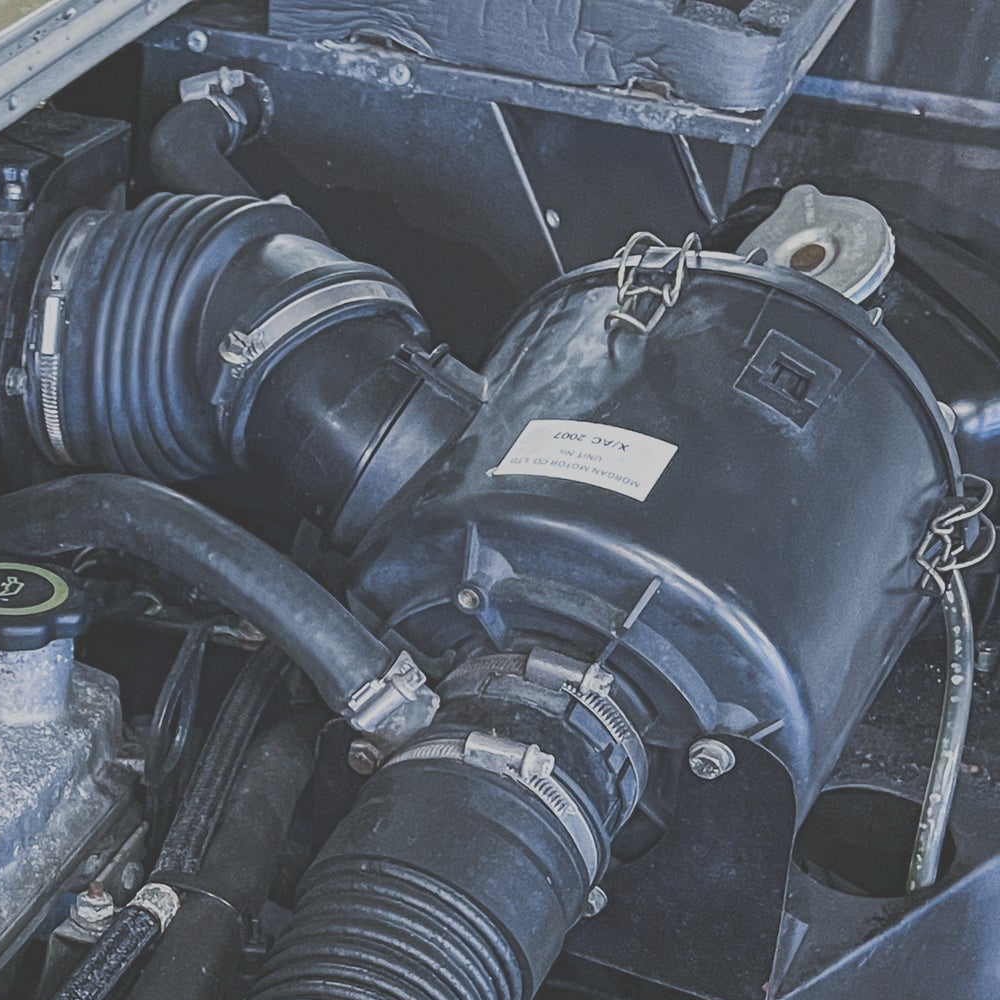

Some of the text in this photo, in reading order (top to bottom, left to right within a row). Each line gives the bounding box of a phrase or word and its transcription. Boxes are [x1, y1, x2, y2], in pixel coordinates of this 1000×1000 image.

[553, 431, 630, 452] X/AC 2007
[576, 451, 603, 462] UNIT
[550, 459, 590, 471] MOTOR
[592, 467, 640, 488] MORGAN
